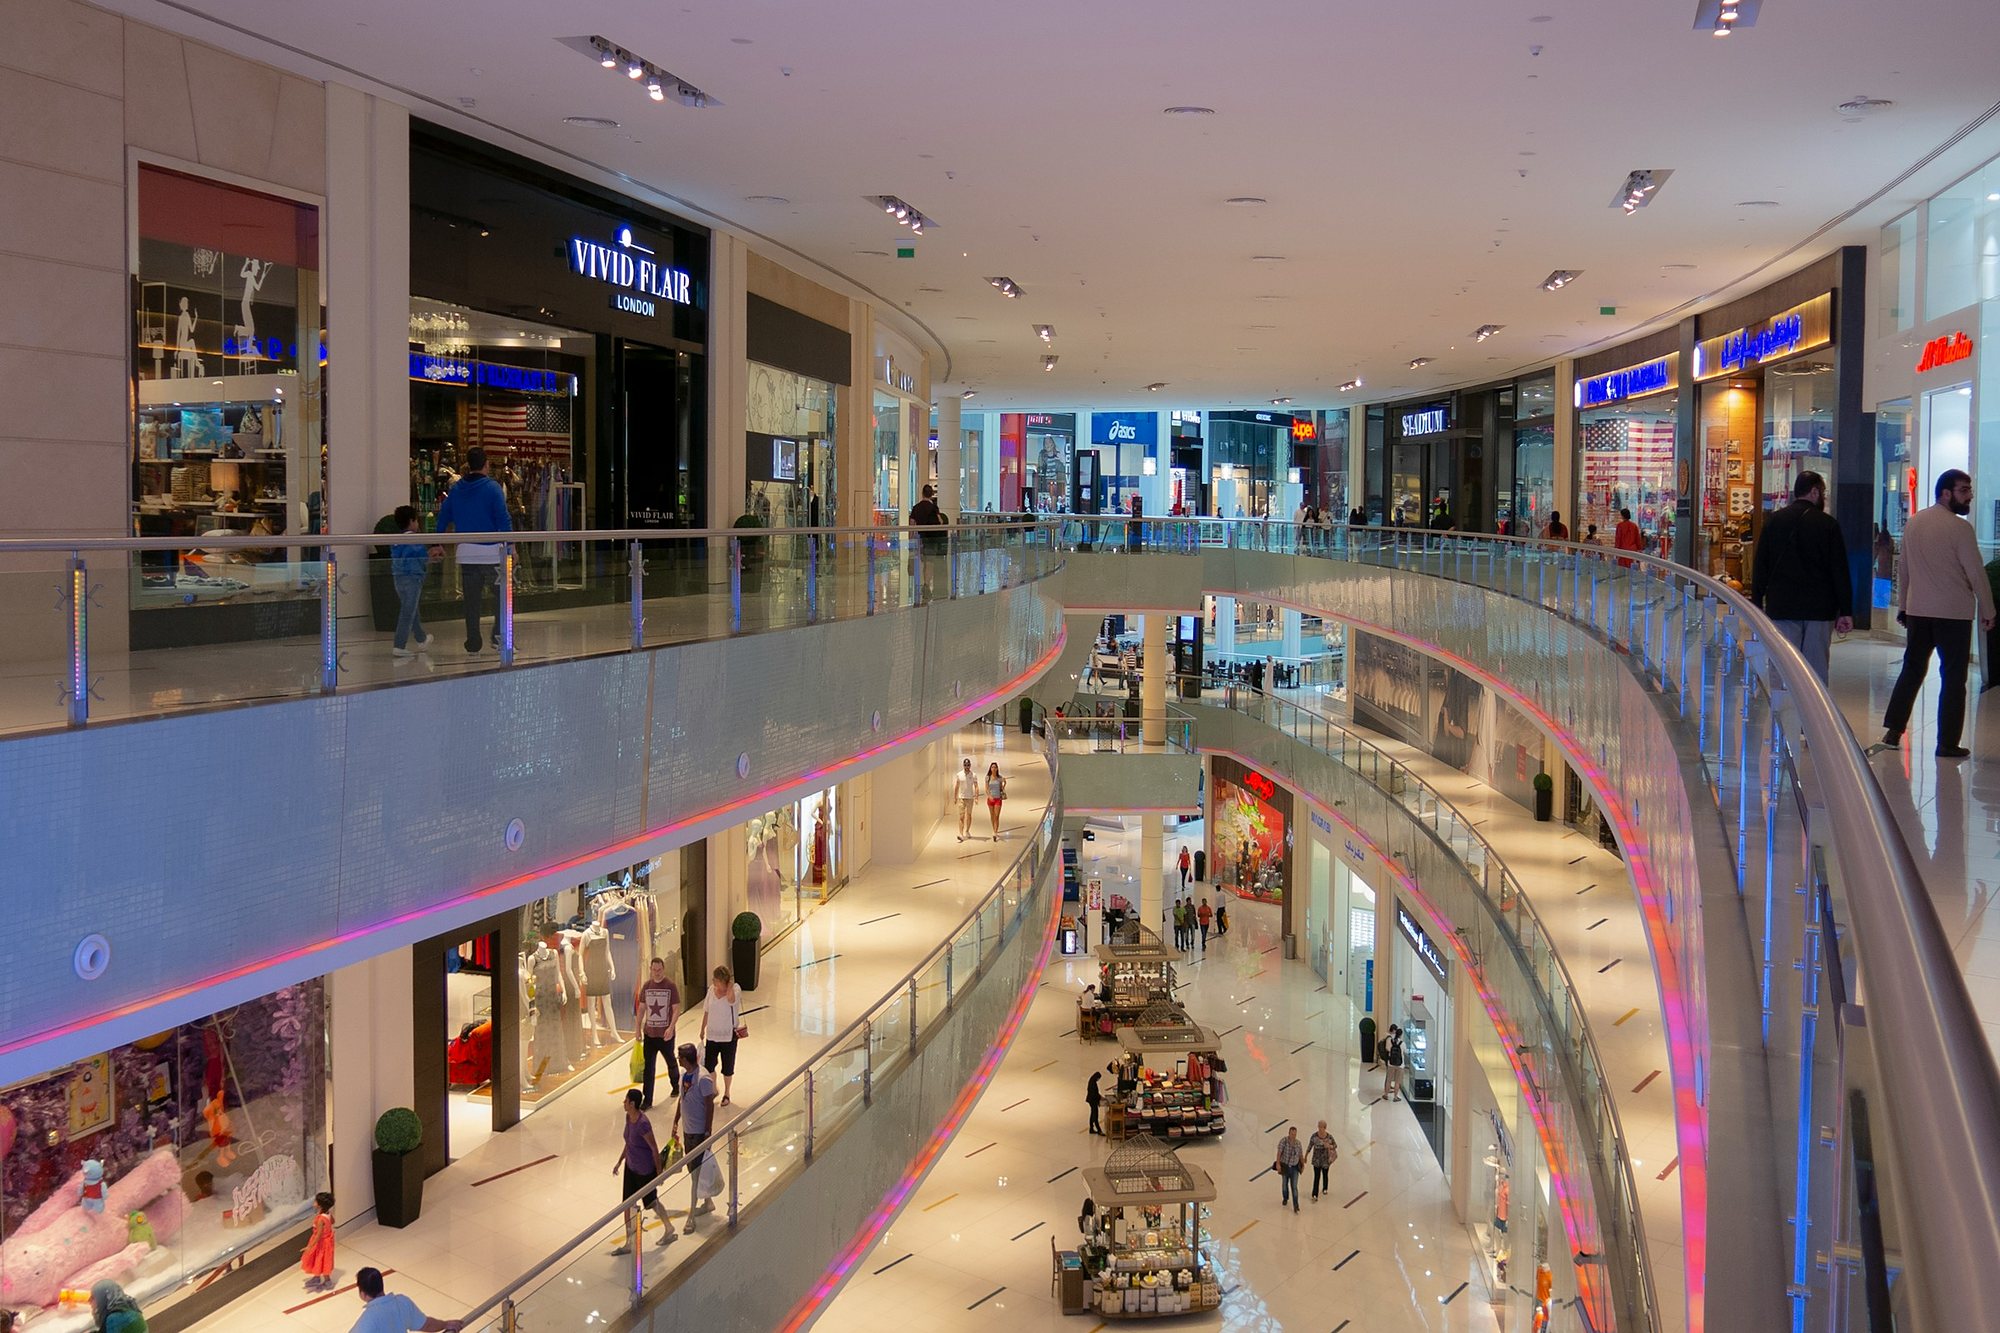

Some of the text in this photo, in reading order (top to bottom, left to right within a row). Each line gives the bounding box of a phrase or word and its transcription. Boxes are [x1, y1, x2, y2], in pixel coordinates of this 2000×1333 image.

[574, 238, 691, 305] VIVID FLAIR
[617, 294, 655, 317] LONDON
[1402, 409, 1444, 437] STADIUM
[631, 511, 652, 519] VIVID
[653, 512, 674, 520] FLAIR
